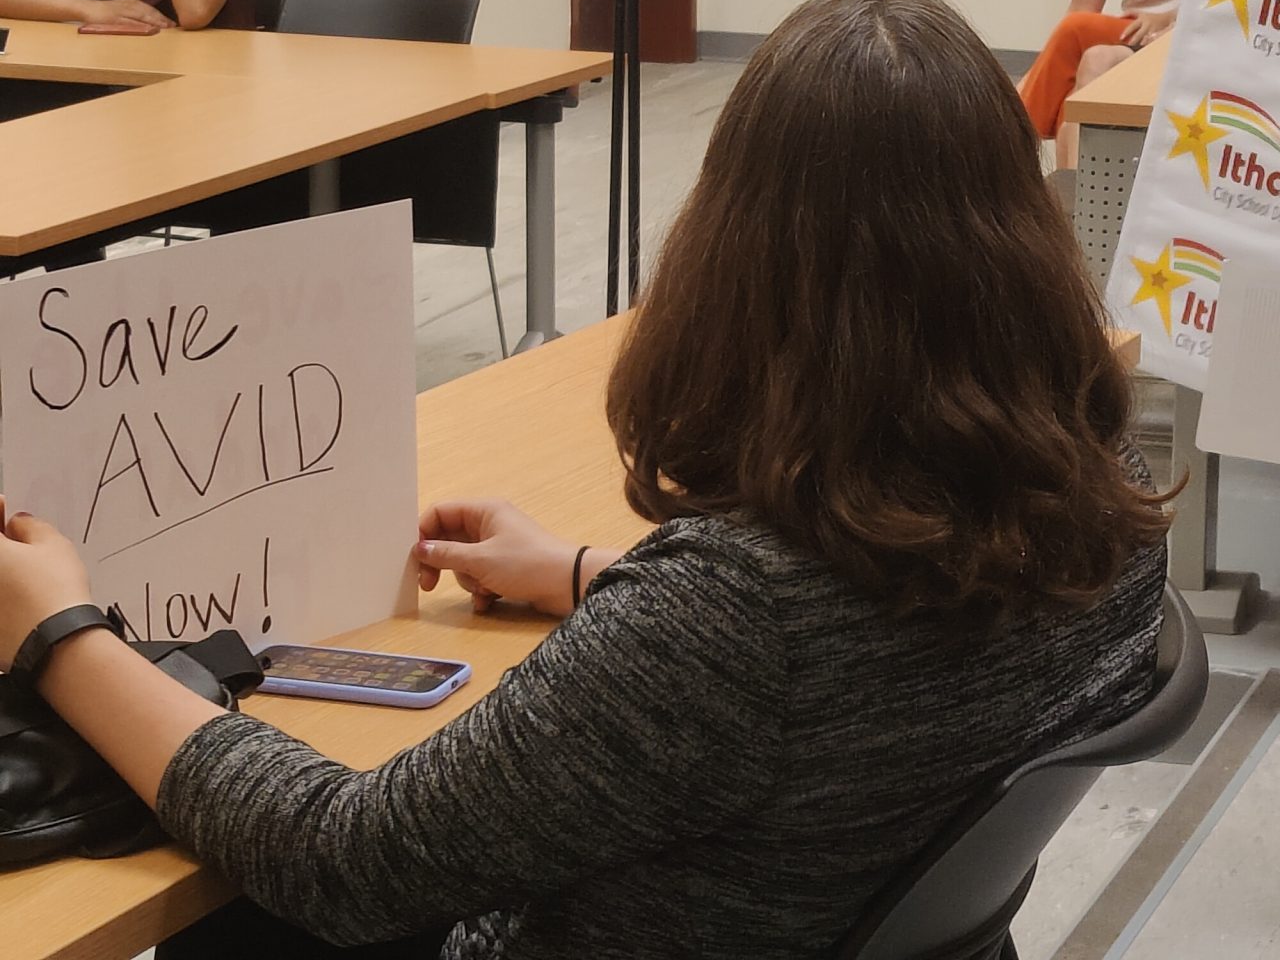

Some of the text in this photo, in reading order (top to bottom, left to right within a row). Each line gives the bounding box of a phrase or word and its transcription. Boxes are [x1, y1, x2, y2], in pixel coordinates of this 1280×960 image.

[1253, 34, 1274, 57] City
[1213, 186, 1233, 208] City
[1236, 193, 1271, 216] School
[29, 286, 239, 410] Save
[82, 362, 343, 544] AVID
